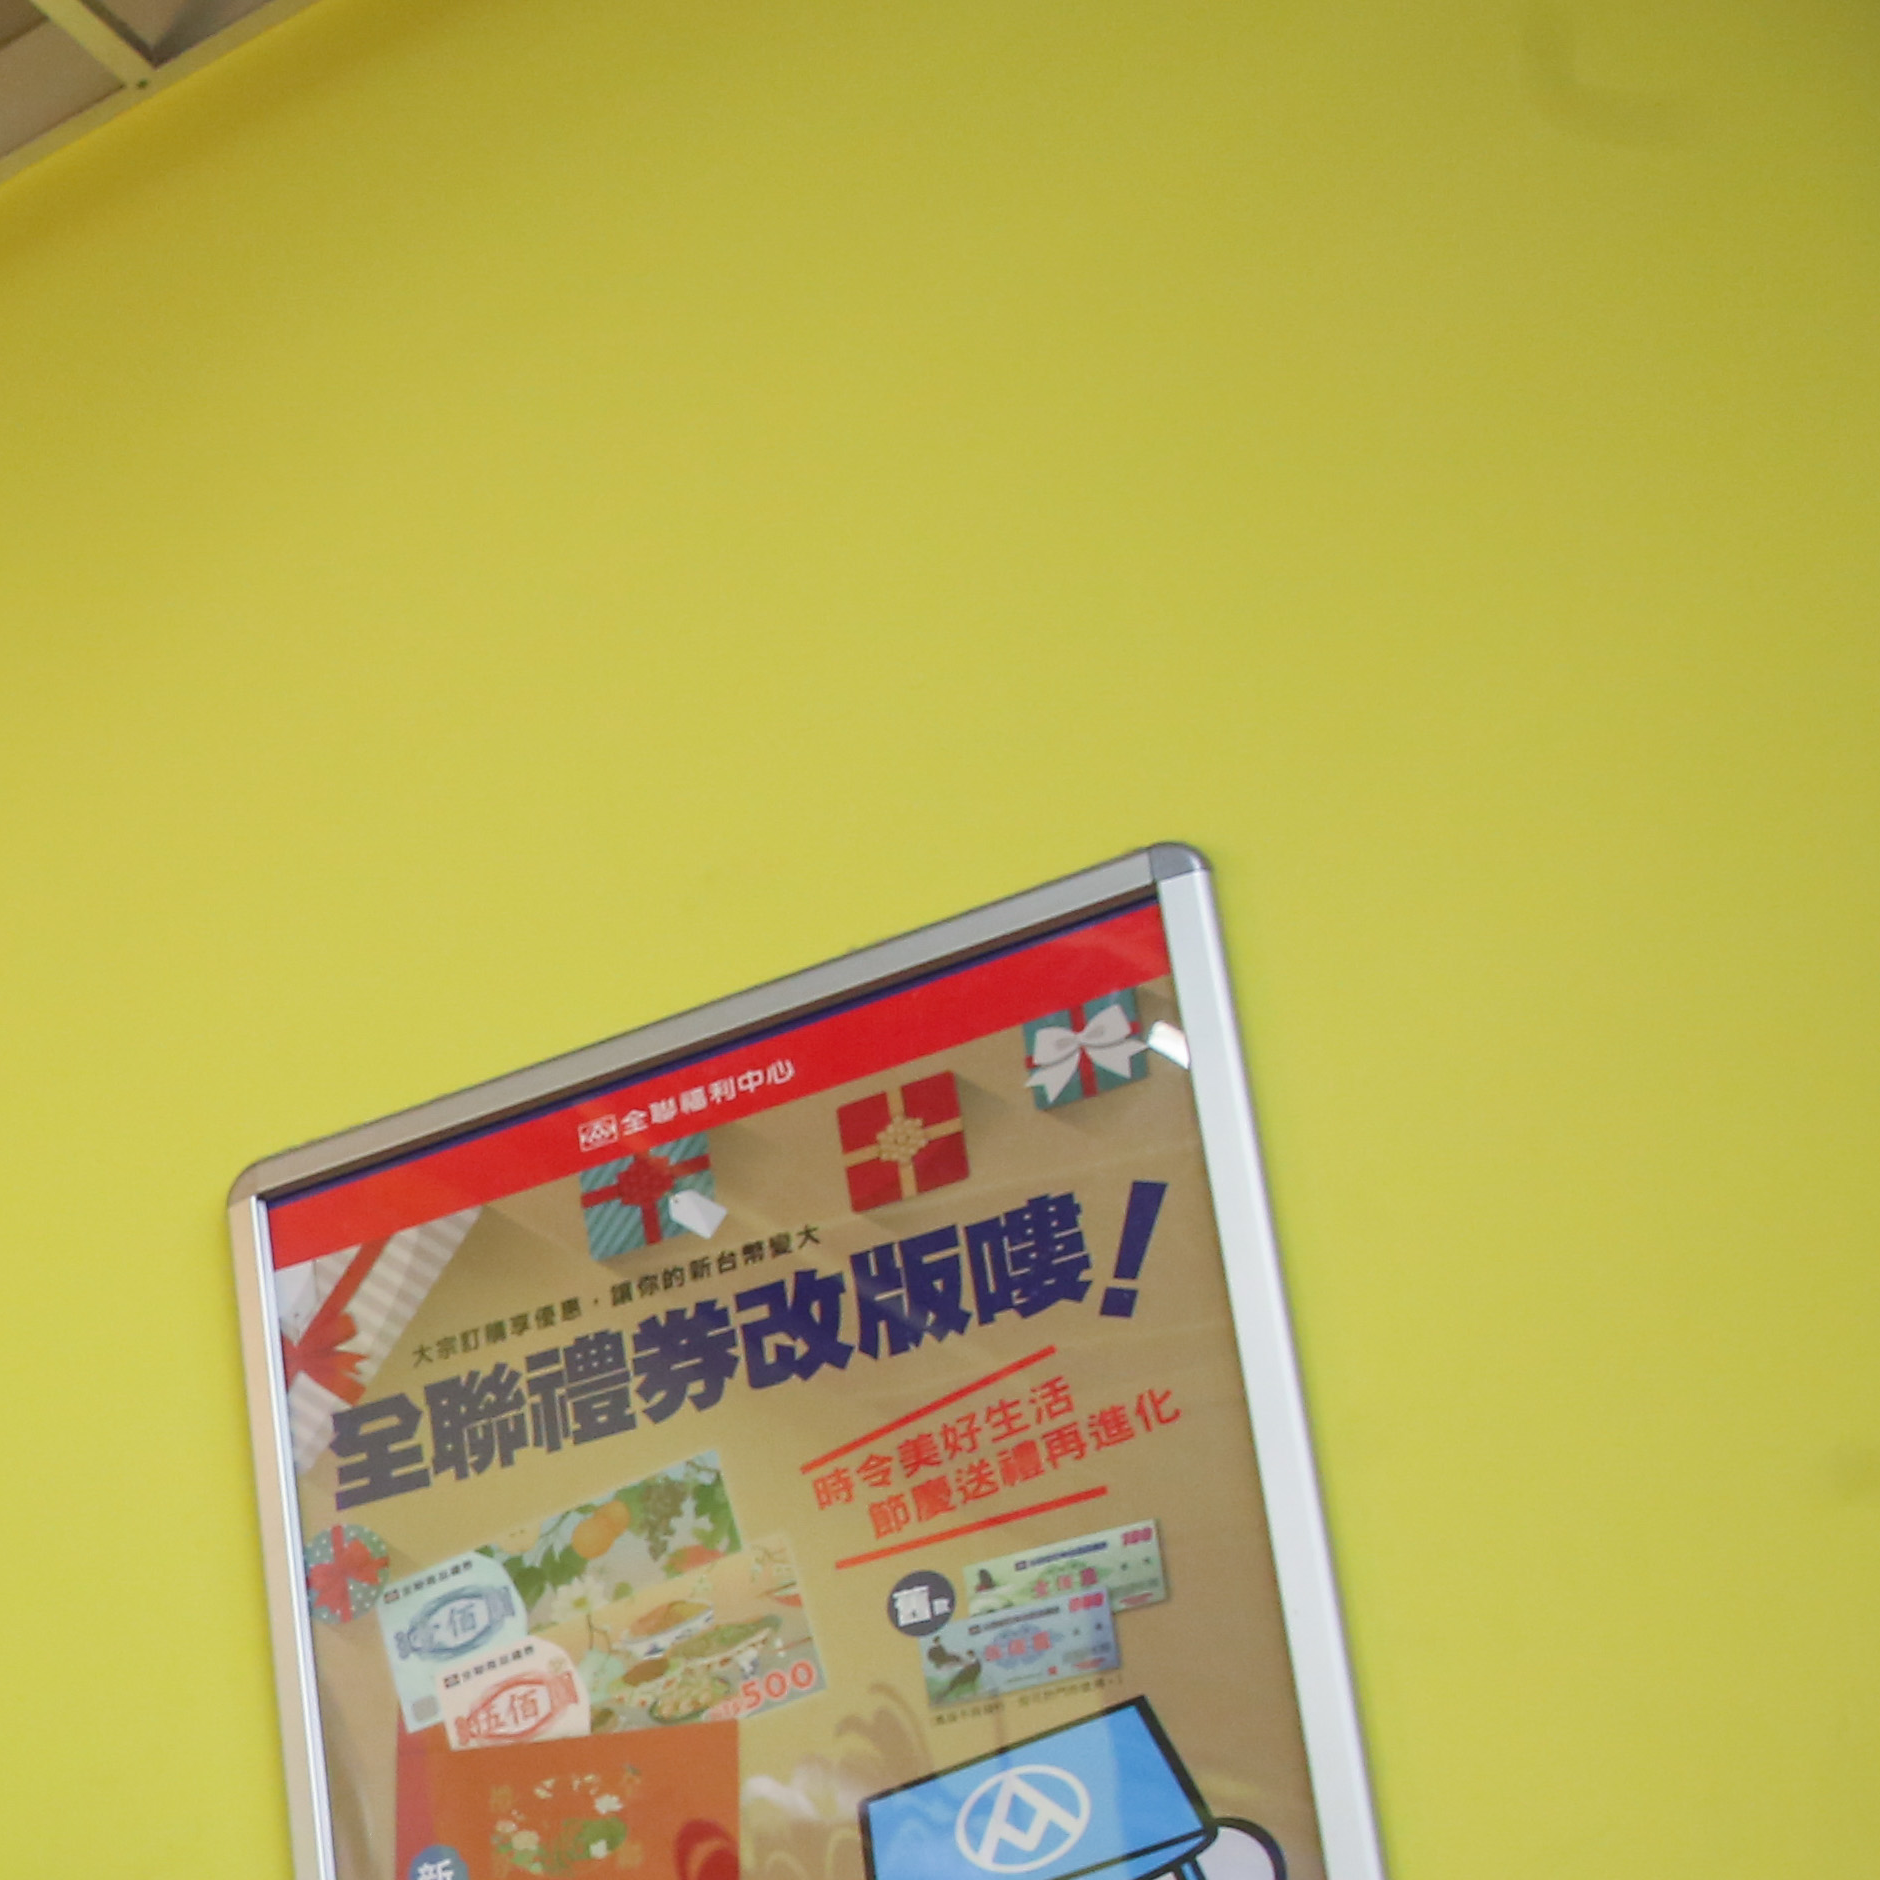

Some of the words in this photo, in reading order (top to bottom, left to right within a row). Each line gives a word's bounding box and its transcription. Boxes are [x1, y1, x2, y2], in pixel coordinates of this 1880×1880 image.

[620, 1057, 797, 1137] 全聯福利中心
[811, 1373, 1077, 1513] 時令美好生活
[866, 1385, 1183, 1541] 節慶送禮再進化
